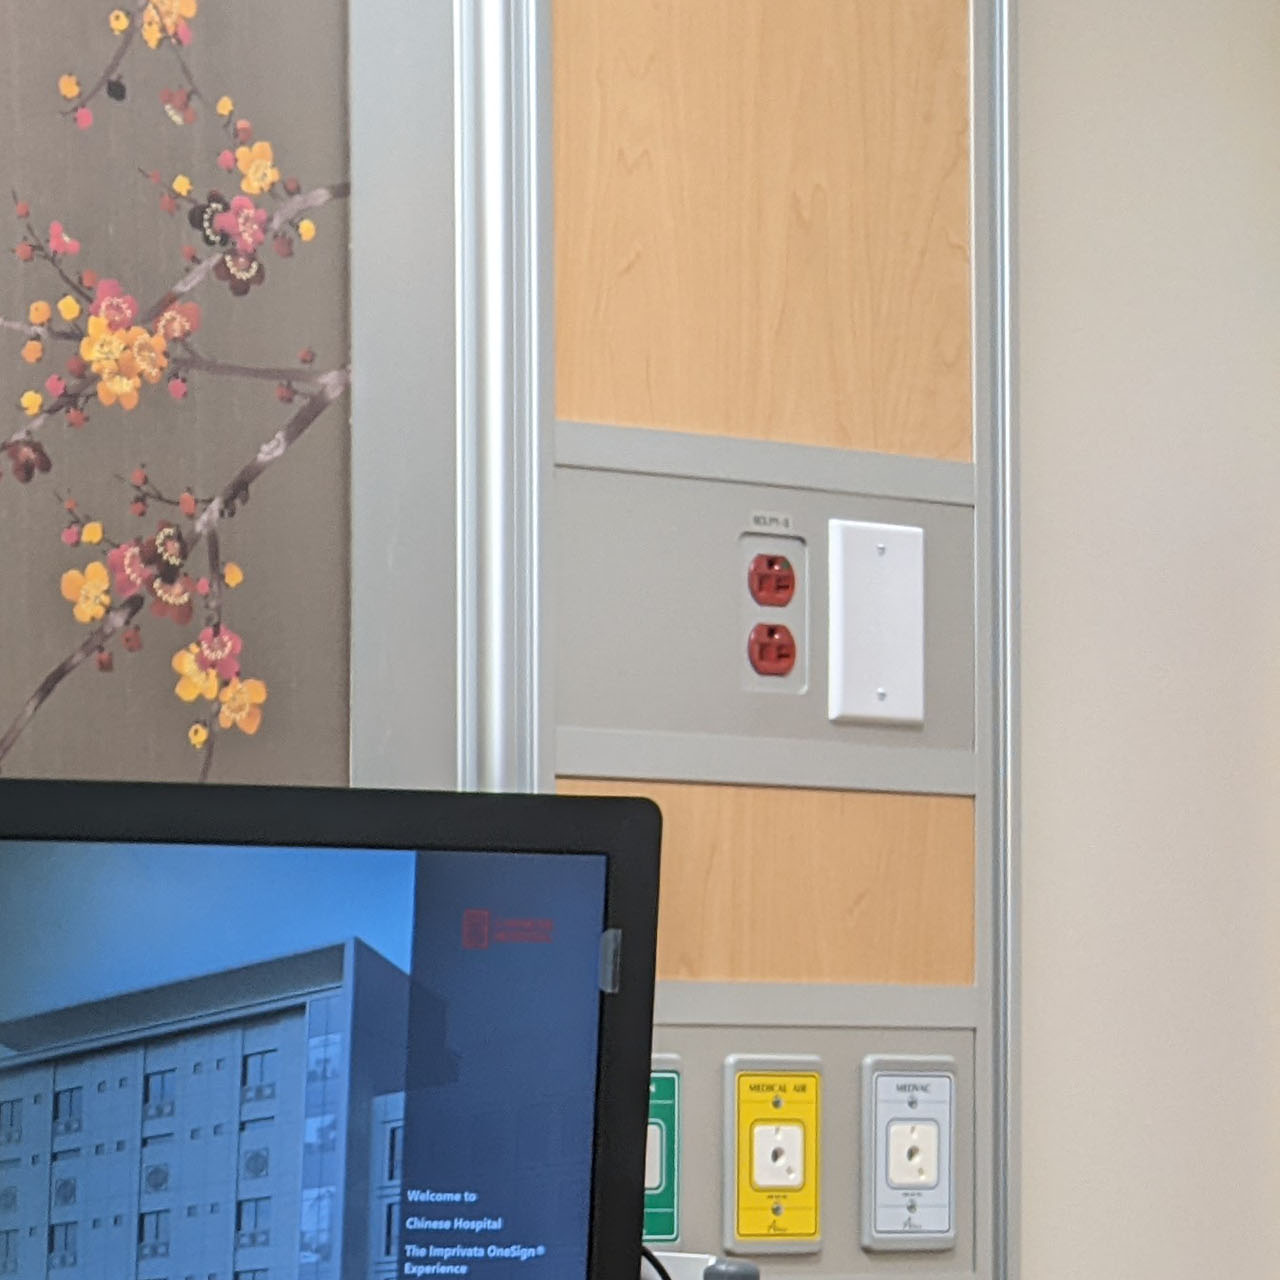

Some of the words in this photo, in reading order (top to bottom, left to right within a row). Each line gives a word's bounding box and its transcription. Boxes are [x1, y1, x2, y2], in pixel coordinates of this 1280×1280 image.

[748, 1083, 787, 1094] MEDICAL
[407, 1190, 462, 1203] Welcome
[464, 1191, 478, 1203] to
[405, 1217, 451, 1230] Chinese
[453, 1217, 503, 1232] Hospital
[405, 1245, 427, 1258] The
[429, 1245, 485, 1260] Imprivata
[404, 1262, 468, 1277] Experience
